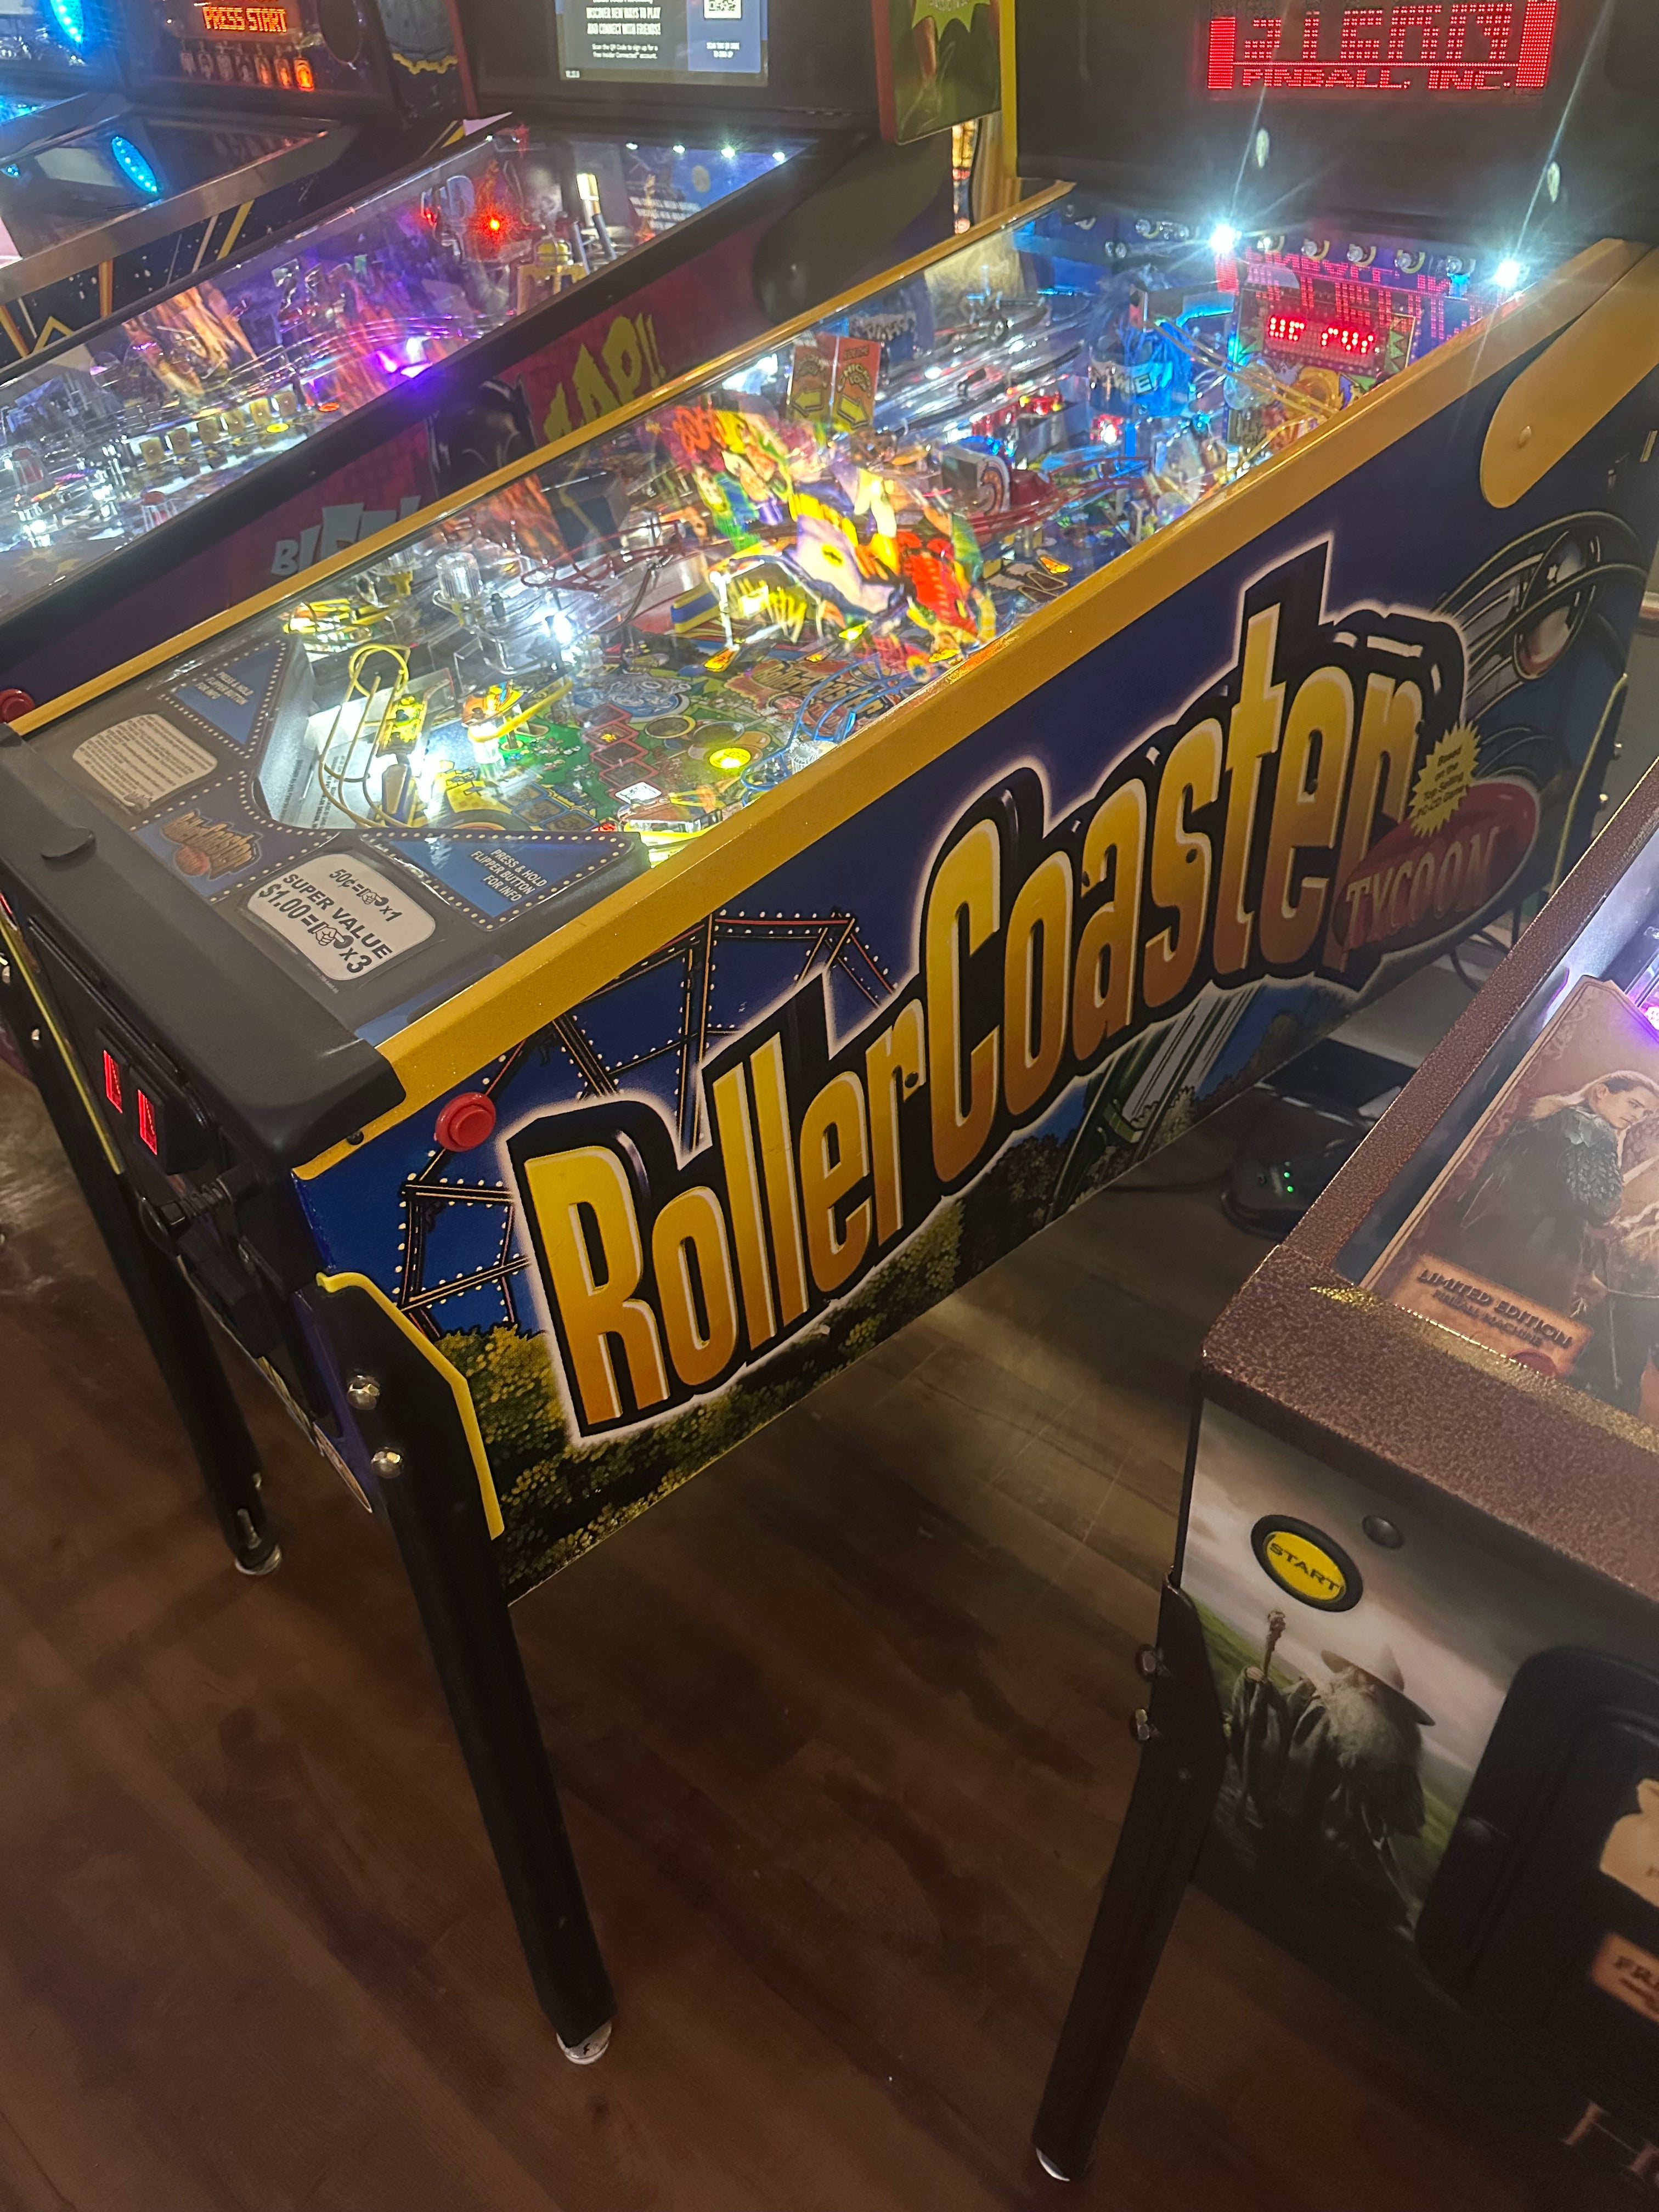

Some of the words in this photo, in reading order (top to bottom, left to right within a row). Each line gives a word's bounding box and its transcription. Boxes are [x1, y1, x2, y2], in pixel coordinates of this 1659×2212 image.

[202, 7, 246, 30] PRESS
[246, 8, 287, 32] START
[1242, 68, 1412, 89] PINBALL,
[1427, 69, 1511, 89] INC.
[471, 850, 505, 874] FLIPPER
[499, 871, 535, 894] BUTTON
[483, 874, 504, 889] FOR
[499, 885, 522, 901] INFO
[490, 849, 519, 868] PRESS
[522, 870, 548, 887] HOLD
[1343, 825, 1500, 950] TYCOON
[283, 873, 335, 910] SUPER
[332, 907, 393, 959] VALUE
[379, 906, 403, 922] x1
[339, 947, 373, 973] x3
[524, 602, 1425, 1426] RollerCoaster
[1417, 1269, 1492, 1306] LIMITED
[1494, 1300, 1573, 1348] EDITION
[1432, 1290, 1479, 1320] PINBALL
[1481, 1312, 1543, 1347] MACHINE
[1269, 1543, 1340, 1590] START
